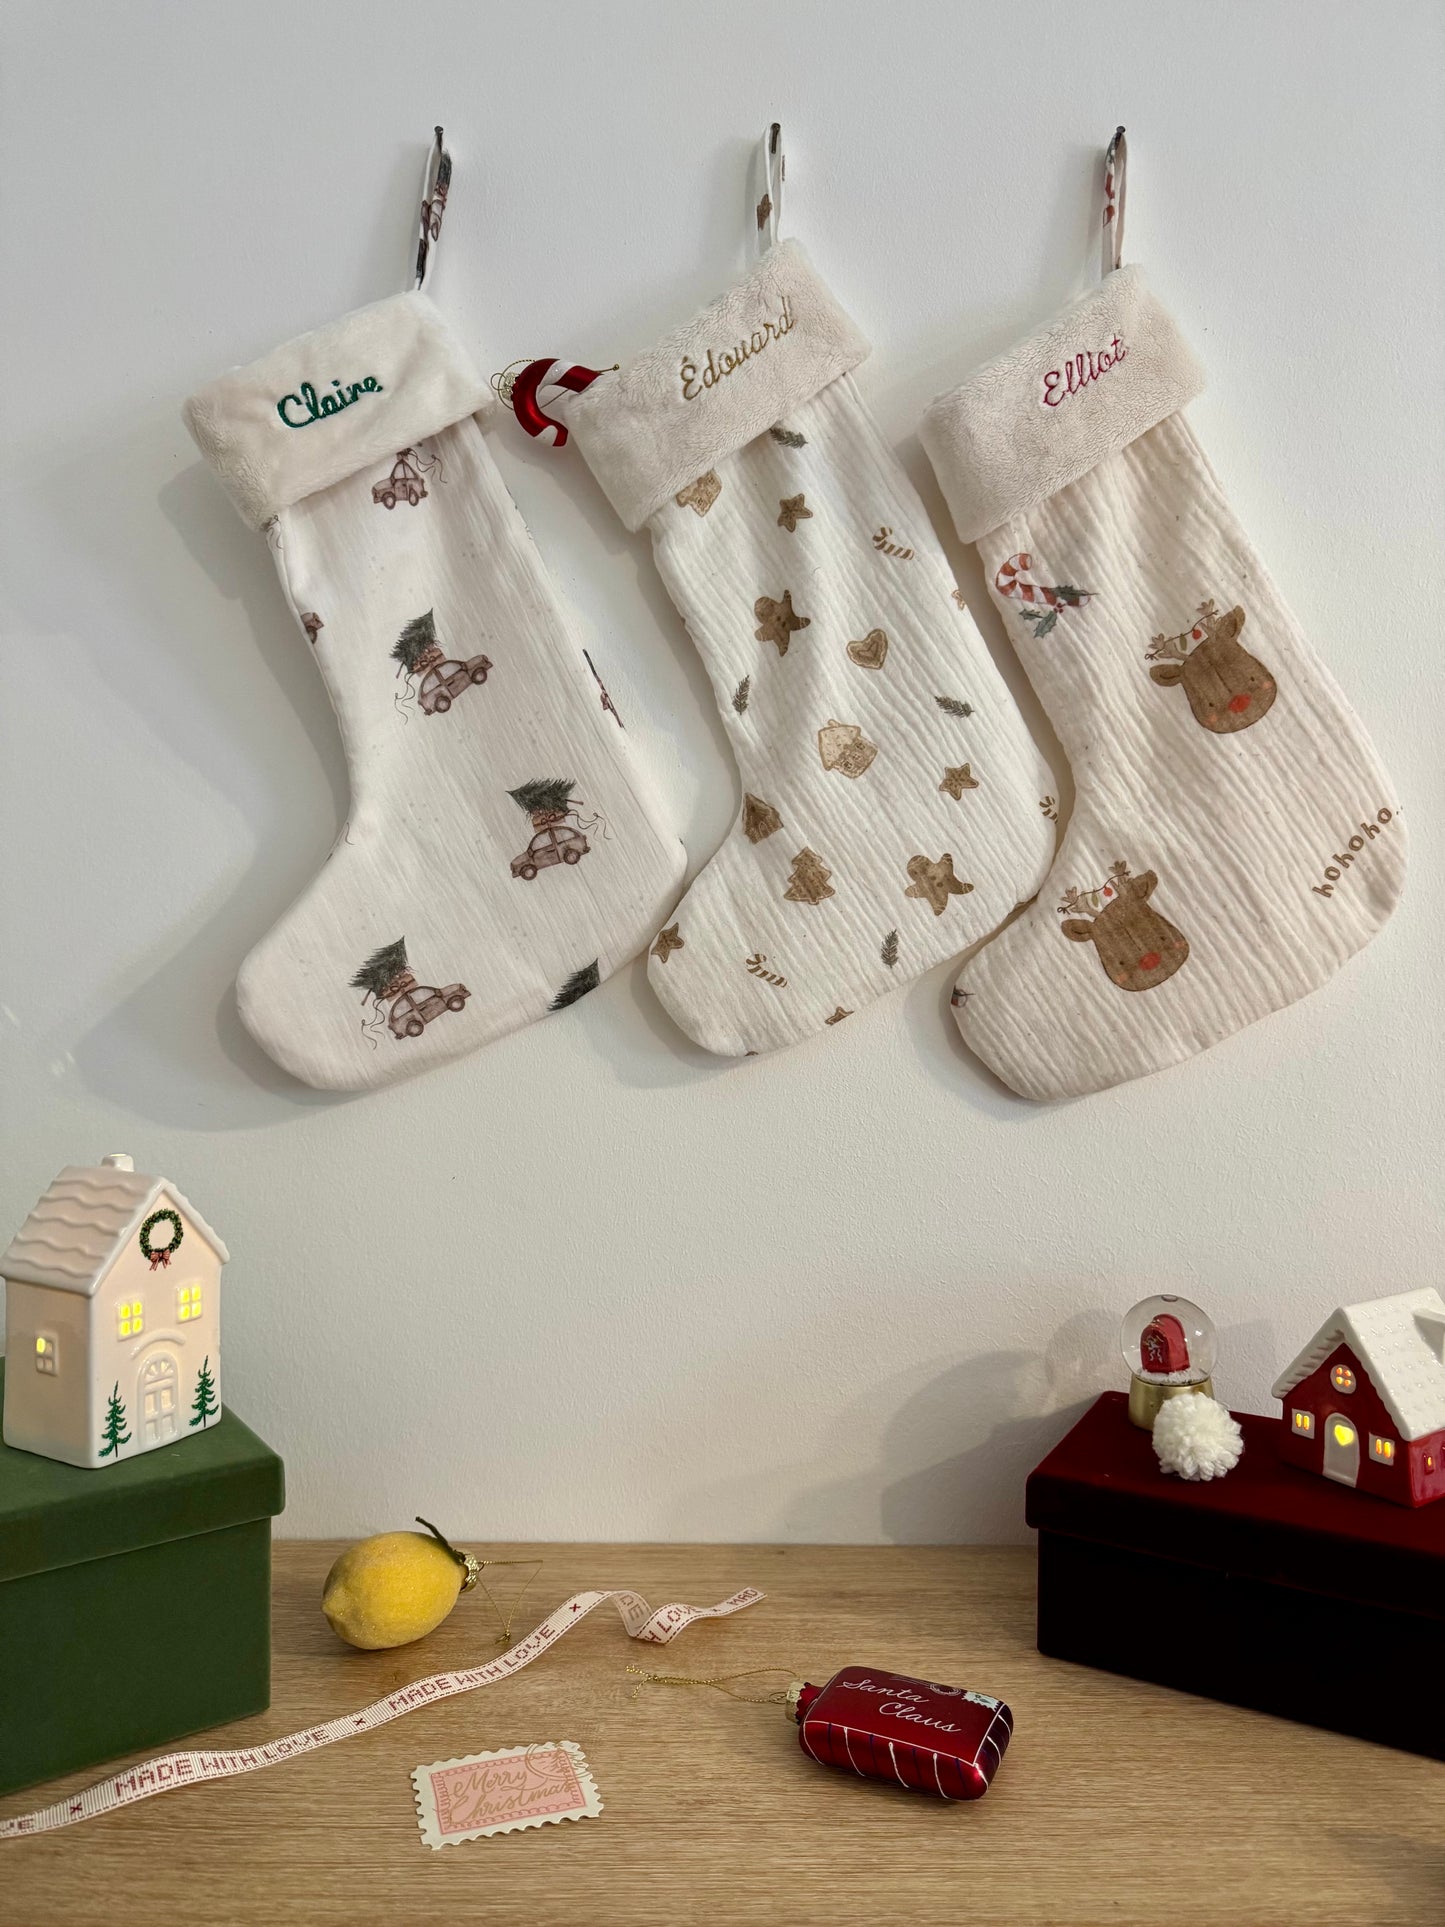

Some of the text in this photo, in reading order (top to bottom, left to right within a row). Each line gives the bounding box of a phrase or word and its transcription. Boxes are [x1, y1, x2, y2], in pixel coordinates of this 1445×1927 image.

[680, 295, 795, 401] Édouard
[1043, 333, 1126, 406] Elliot
[277, 376, 383, 428] Claire
[388, 1624, 556, 1711] MADE WITH LOVE
[836, 1678, 929, 1704] Santa
[878, 1701, 962, 1733] Claus
[115, 1729, 330, 1797] MADE WITH LOVE
[452, 1769, 546, 1798] Merry
[450, 1780, 571, 1825] Christmas
